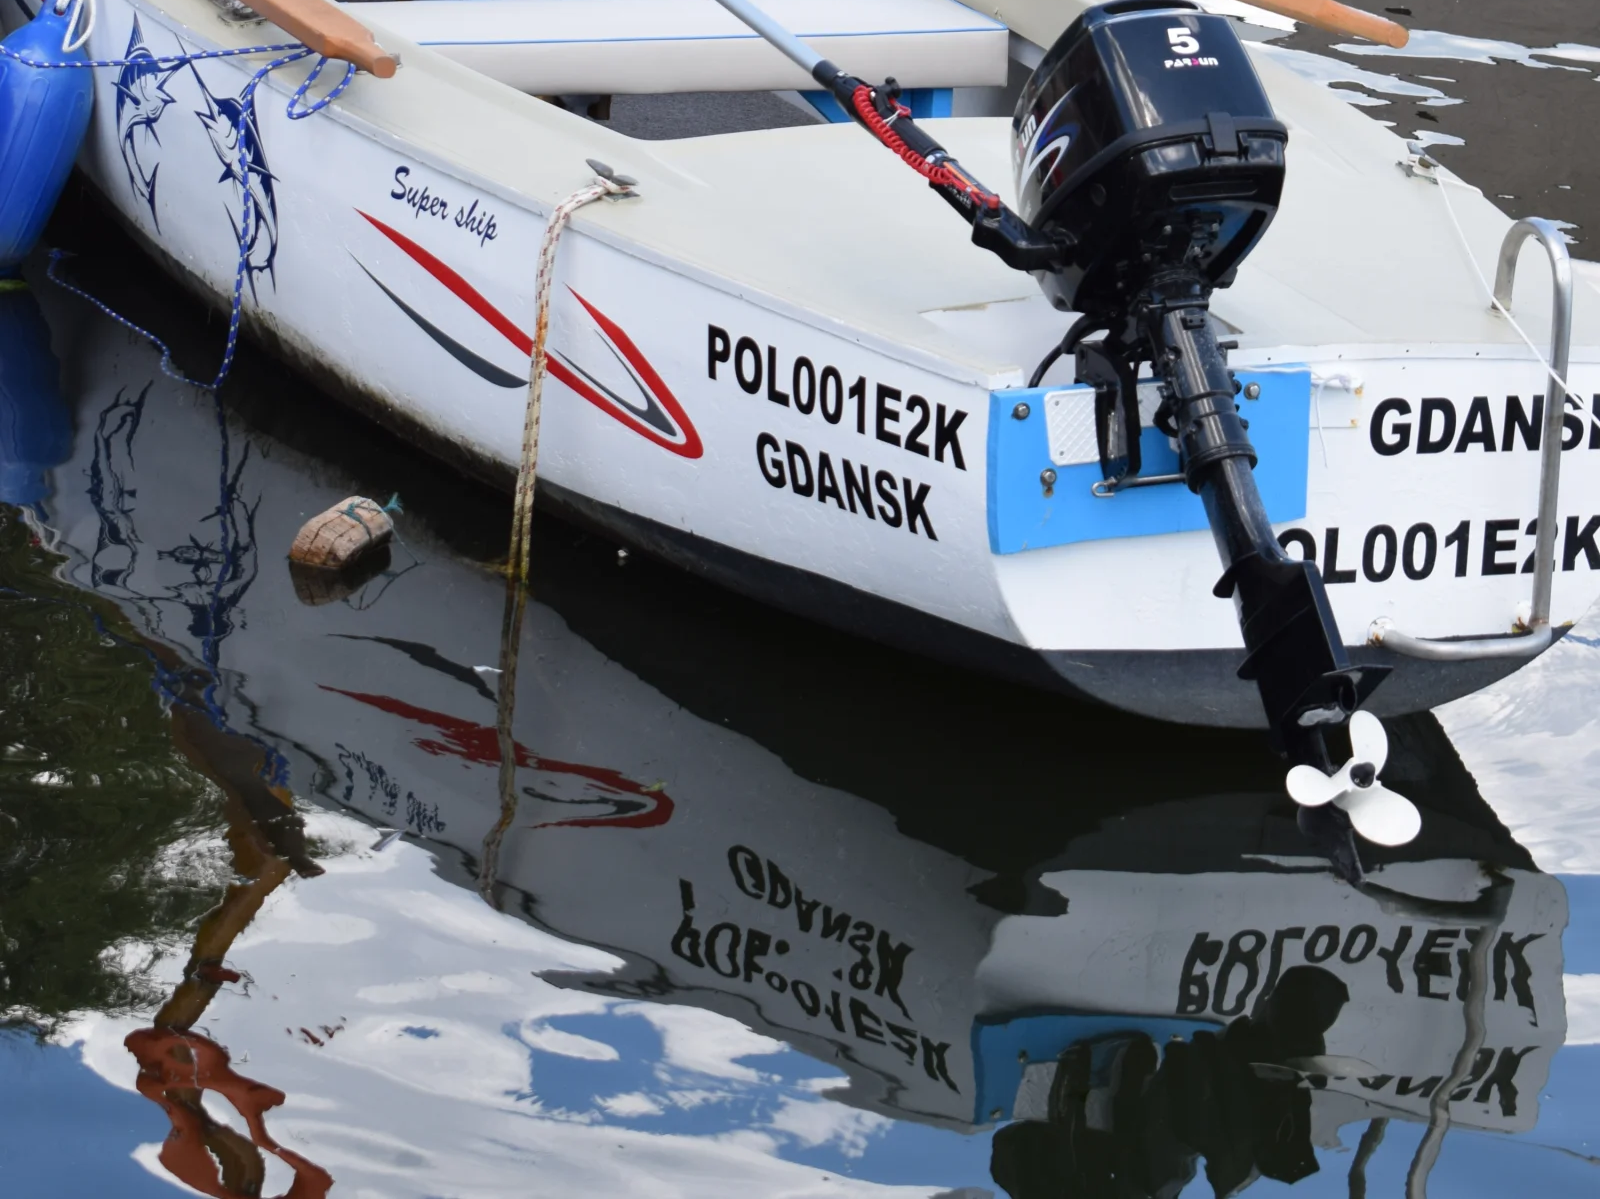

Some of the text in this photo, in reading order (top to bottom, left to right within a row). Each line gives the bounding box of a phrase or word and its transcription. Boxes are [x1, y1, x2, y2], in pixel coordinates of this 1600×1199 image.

[1167, 27, 1200, 55] 5
[391, 165, 498, 248] Super ship
[708, 323, 969, 472] POL001E2K
[756, 431, 939, 542] GDANSK
